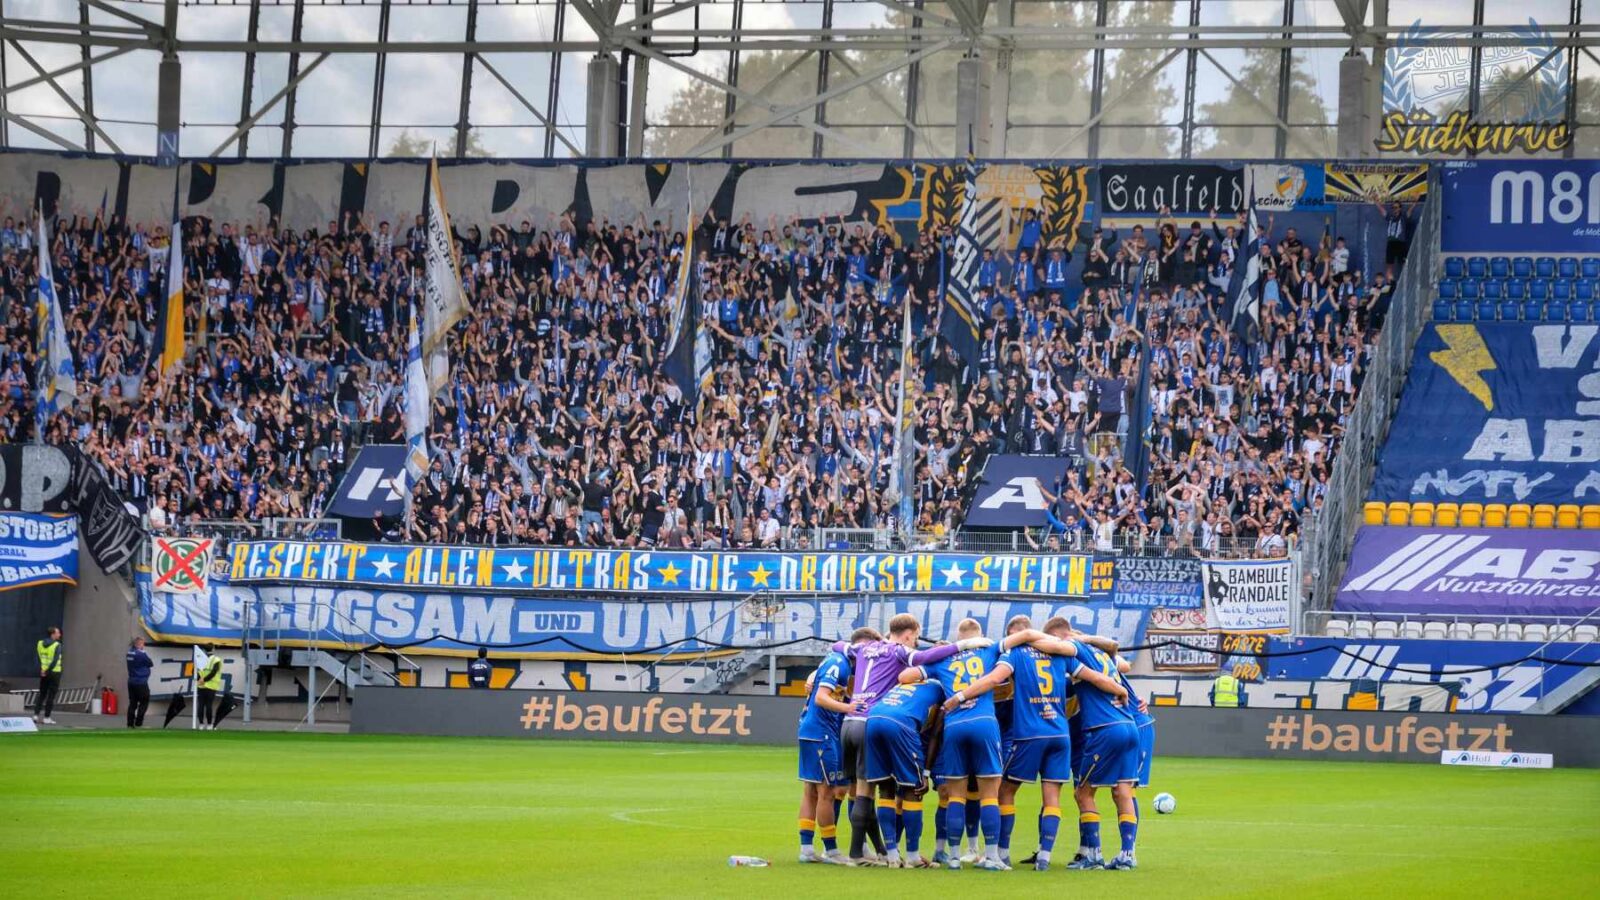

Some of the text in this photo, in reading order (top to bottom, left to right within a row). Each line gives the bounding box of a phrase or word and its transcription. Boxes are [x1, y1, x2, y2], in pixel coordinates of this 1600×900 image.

[1106, 174, 1244, 213] Saalfeld
[230, 543, 1086, 595] RESPEKT ALLEN ULTRAS DIE DRAUSSEN STEH'N
[1115, 559, 1201, 570] ZUKUNFTS
[1120, 570, 1198, 582] KONZEPT
[1229, 566, 1288, 584] BAMBULE
[1114, 593, 1200, 606] UMSETZEN
[1117, 581, 1198, 594] KONSEQUENT
[1229, 584, 1288, 603] RANDALE
[138, 583, 514, 645] UNBEUGSAM
[534, 613, 581, 632] UND
[862, 658, 874, 691] 1
[949, 657, 984, 692] 29
[1035, 659, 1053, 695] 5
[520, 696, 751, 737] #baufetzt
[1266, 714, 1513, 753] #baufetzt
